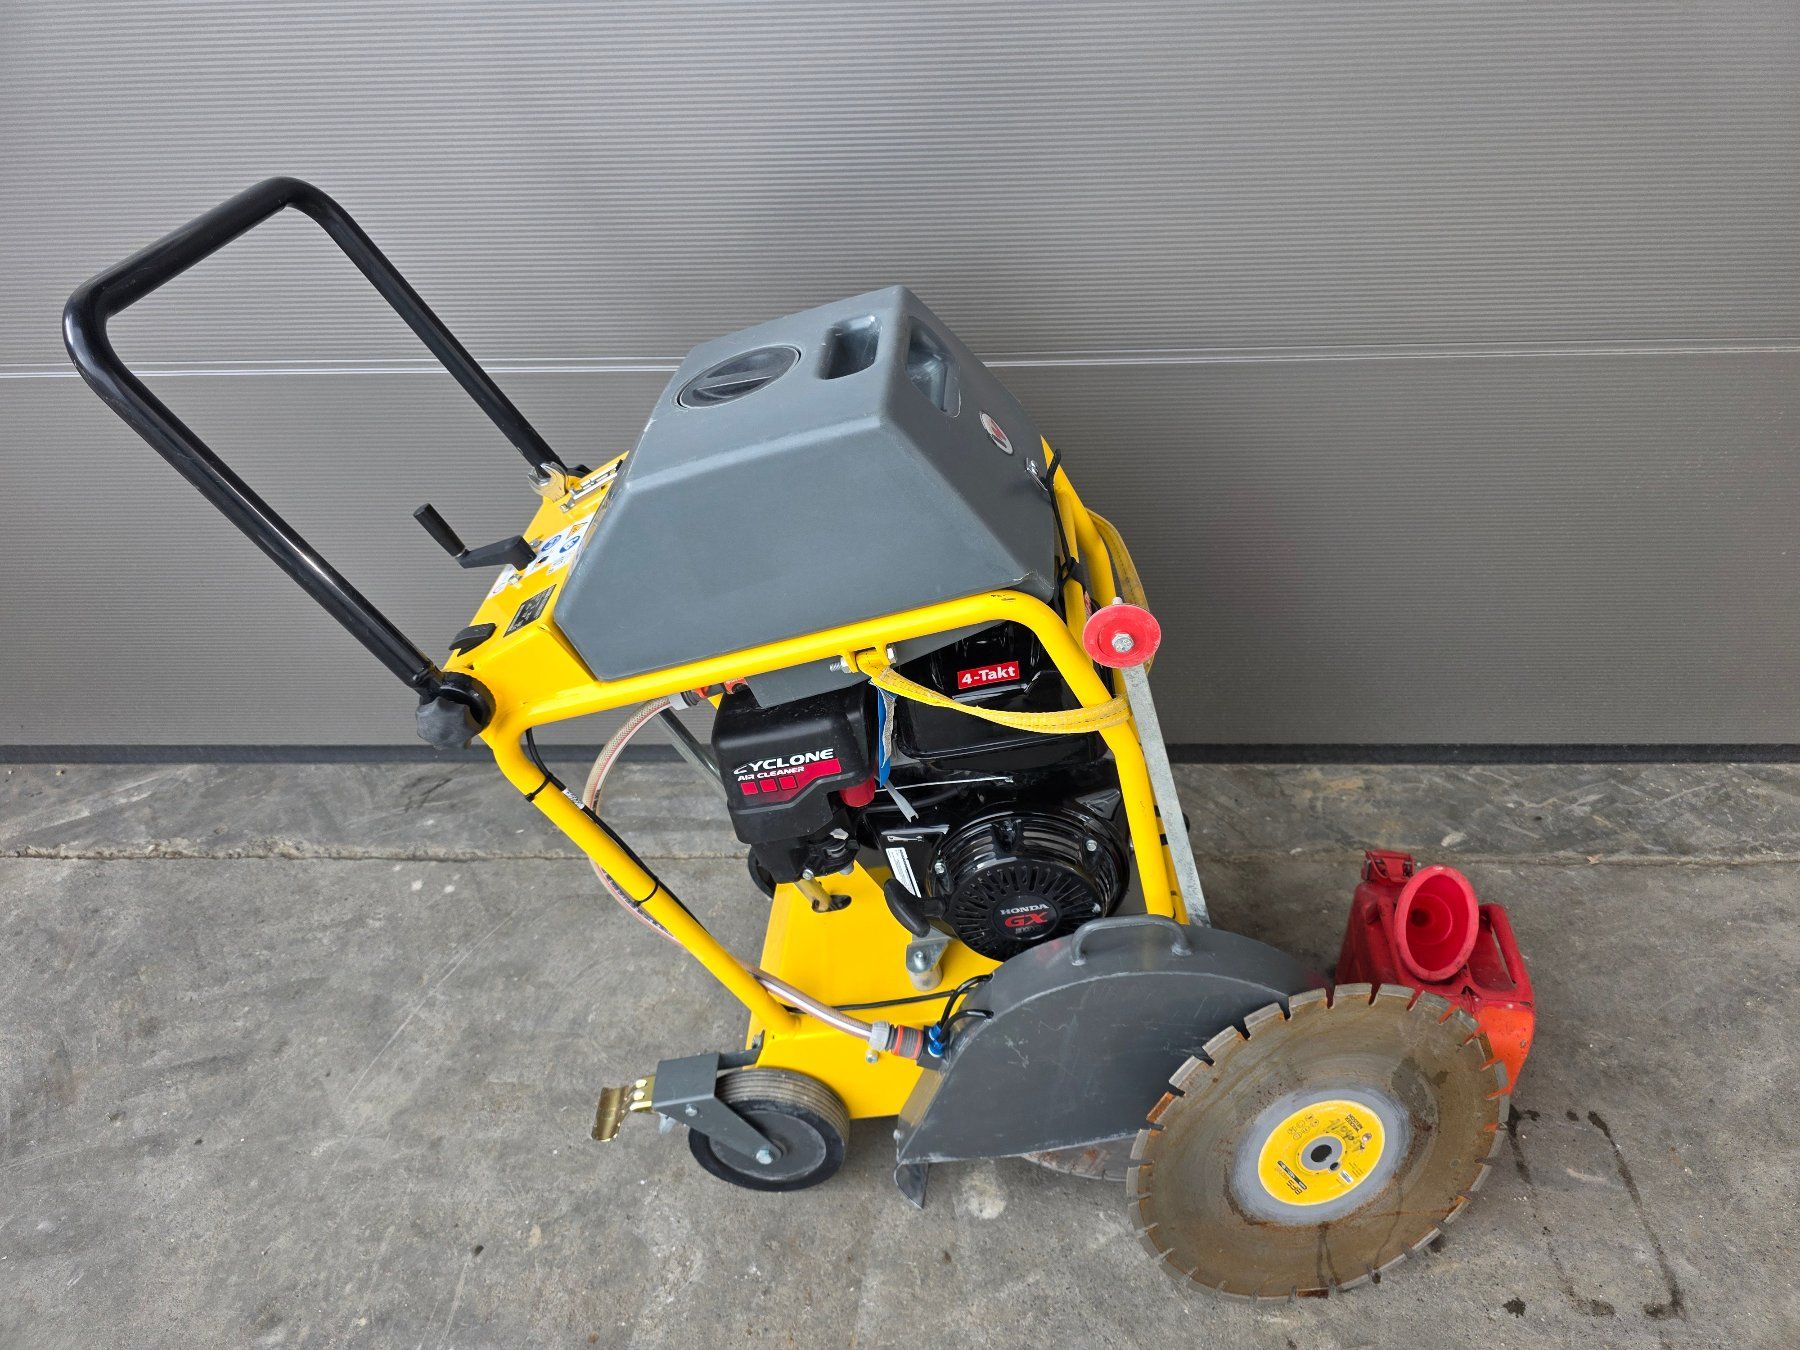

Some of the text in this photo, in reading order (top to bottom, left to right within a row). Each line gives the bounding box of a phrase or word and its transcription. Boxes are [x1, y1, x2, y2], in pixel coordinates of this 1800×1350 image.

[961, 666, 1016, 684] 4-Takt
[733, 748, 834, 775] CYCLONE
[737, 766, 805, 782] AIR CLEANER
[1000, 903, 1050, 915] HONDA
[1004, 911, 1049, 928] GX
